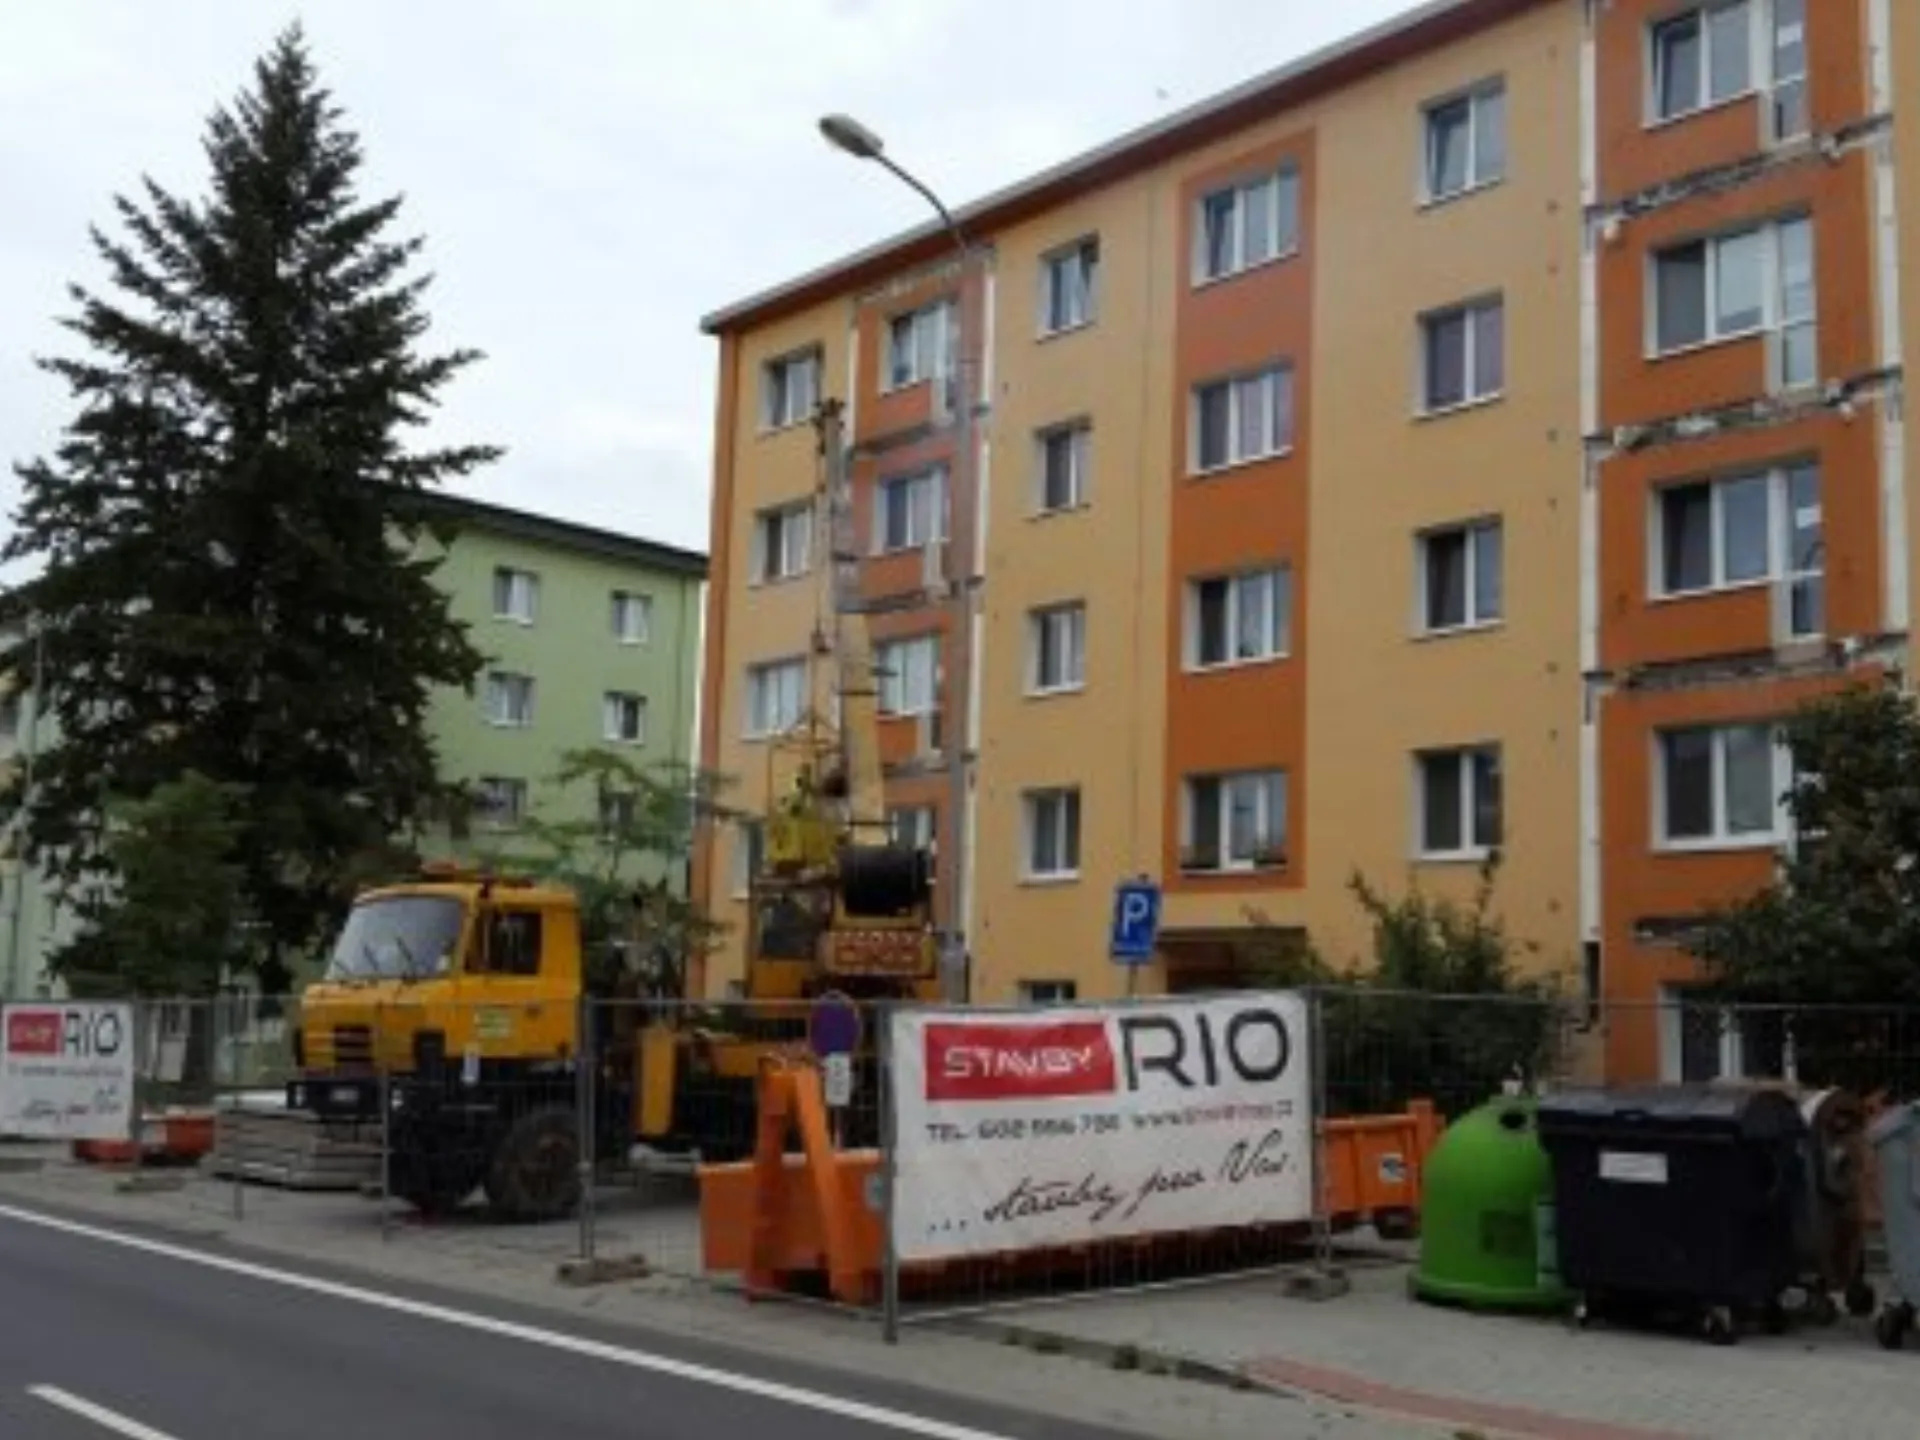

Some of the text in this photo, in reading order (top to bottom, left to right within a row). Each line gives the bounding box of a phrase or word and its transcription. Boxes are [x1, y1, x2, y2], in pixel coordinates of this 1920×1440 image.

[1123, 892, 1149, 938] P
[64, 1011, 122, 1057] RIO
[944, 1009, 1290, 1091] STAVBY RIO
